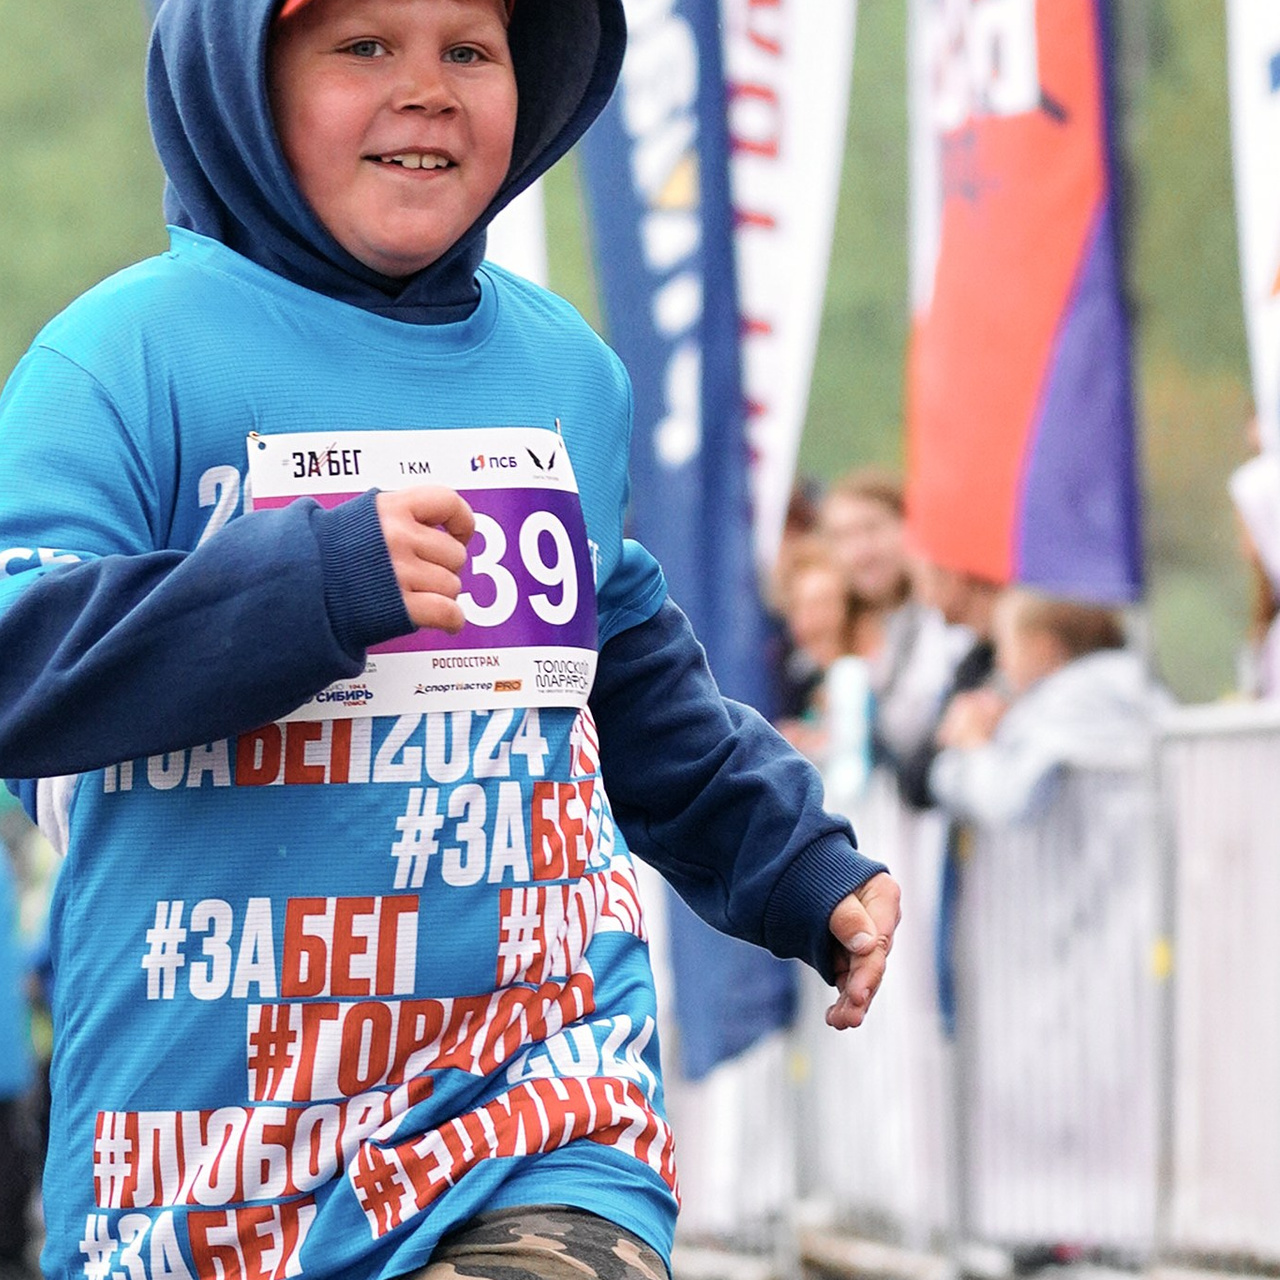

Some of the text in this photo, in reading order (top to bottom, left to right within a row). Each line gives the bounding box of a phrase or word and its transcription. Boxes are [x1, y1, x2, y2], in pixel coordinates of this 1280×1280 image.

[488, 456, 518, 469] ПСБ
[456, 510, 579, 628] 39
[431, 655, 500, 669] РОСГОССТРАХ
[494, 680, 521, 691] PRO
[316, 689, 374, 703] СИБИРЬ
[141, 894, 420, 1001] #ЗАБЕГ
